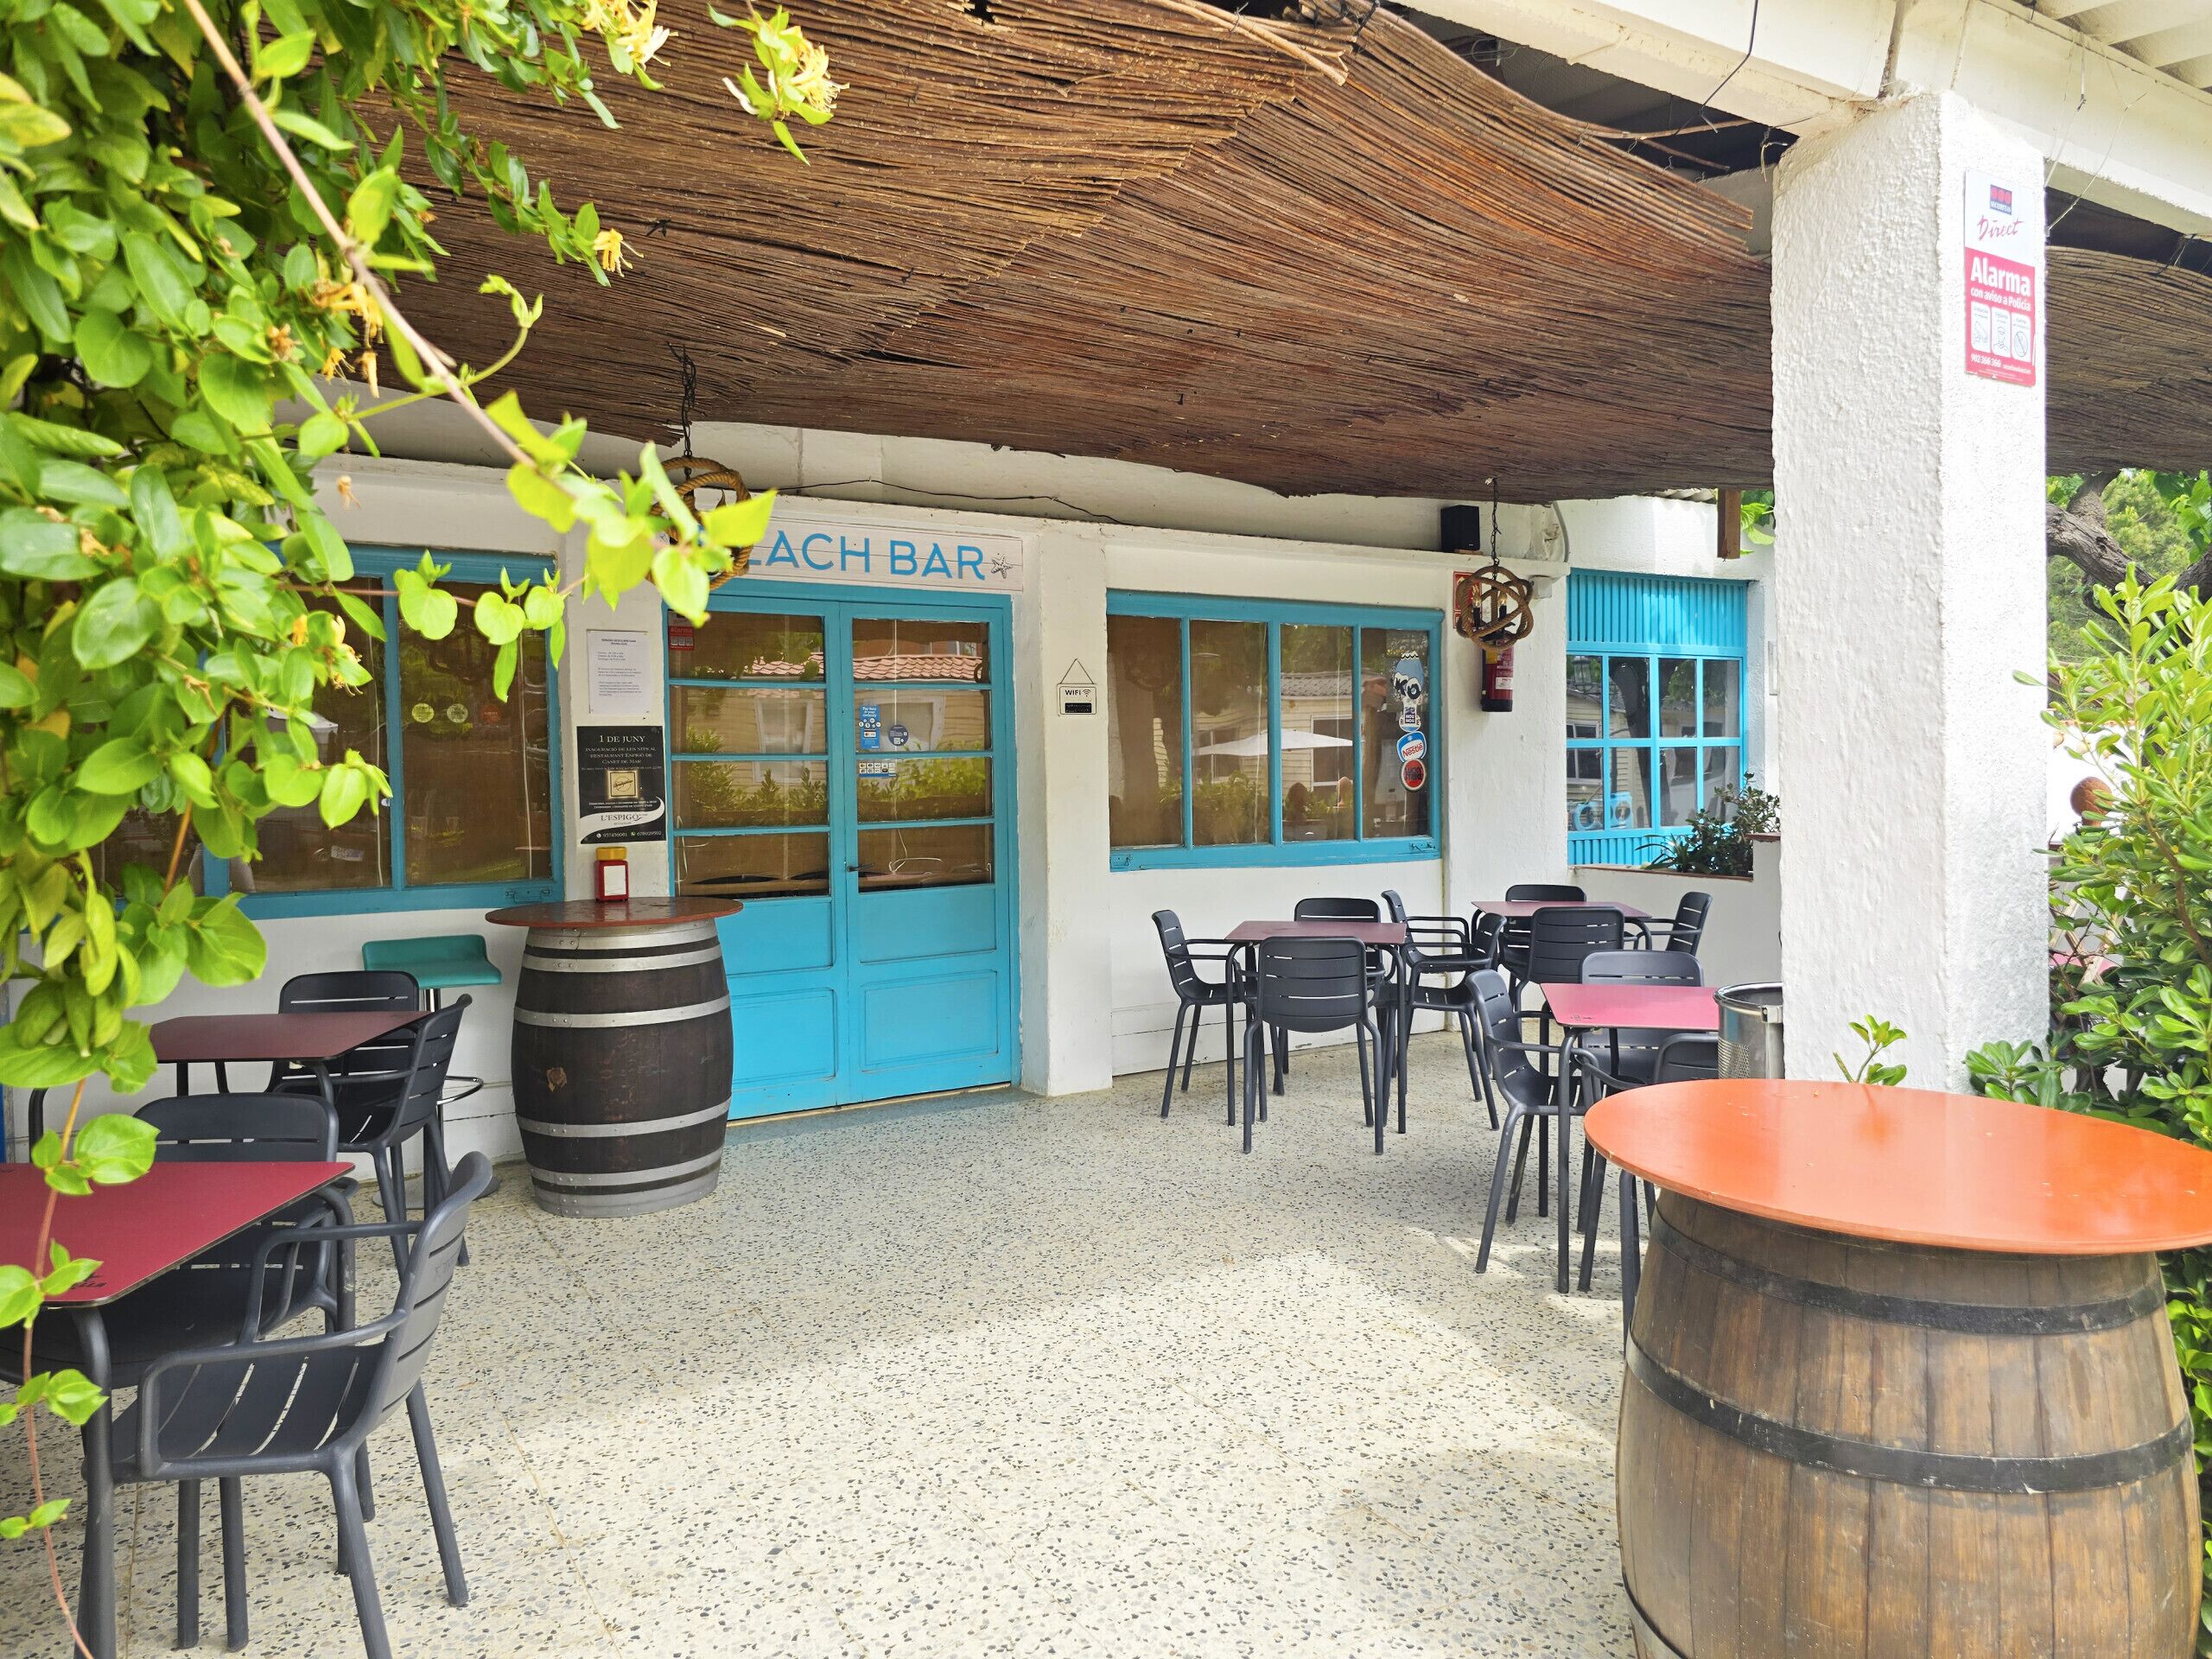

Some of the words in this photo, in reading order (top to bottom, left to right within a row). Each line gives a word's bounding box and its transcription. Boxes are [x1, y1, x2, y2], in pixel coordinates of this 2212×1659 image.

[1977, 214, 2025, 241] Direct
[1970, 256, 2031, 297] Alarma
[1970, 287, 1983, 299] con
[1984, 289, 2002, 304] aviso
[2002, 296, 2008, 306] a
[2007, 295, 2031, 312] Policía
[890, 539, 986, 581] BAR
[600, 734, 604, 743] 1
[622, 735, 645, 744] JUNY
[1402, 742, 1425, 758] Nestlé
